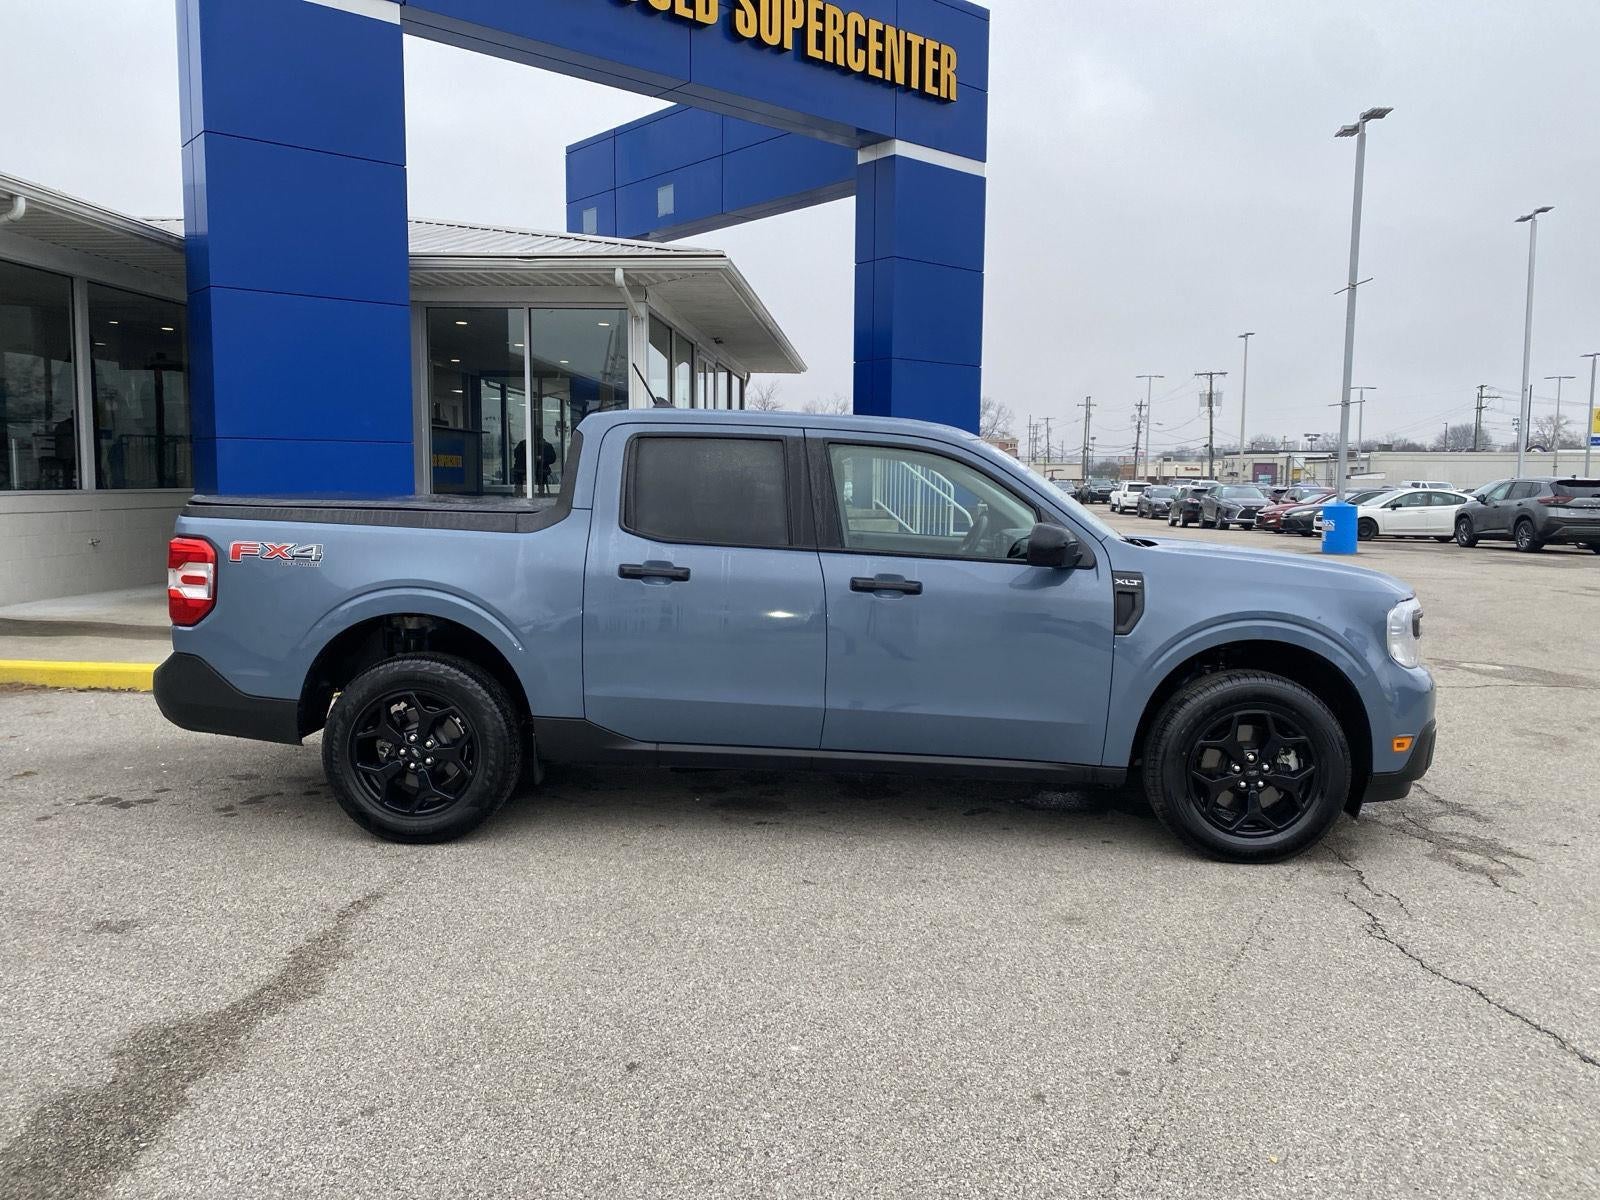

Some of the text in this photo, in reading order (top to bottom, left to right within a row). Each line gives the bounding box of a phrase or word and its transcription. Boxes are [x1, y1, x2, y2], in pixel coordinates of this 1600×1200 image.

[735, 0, 957, 101] SUPERCENTER
[229, 541, 323, 563] FX4
[1115, 578, 1142, 586] XLT
